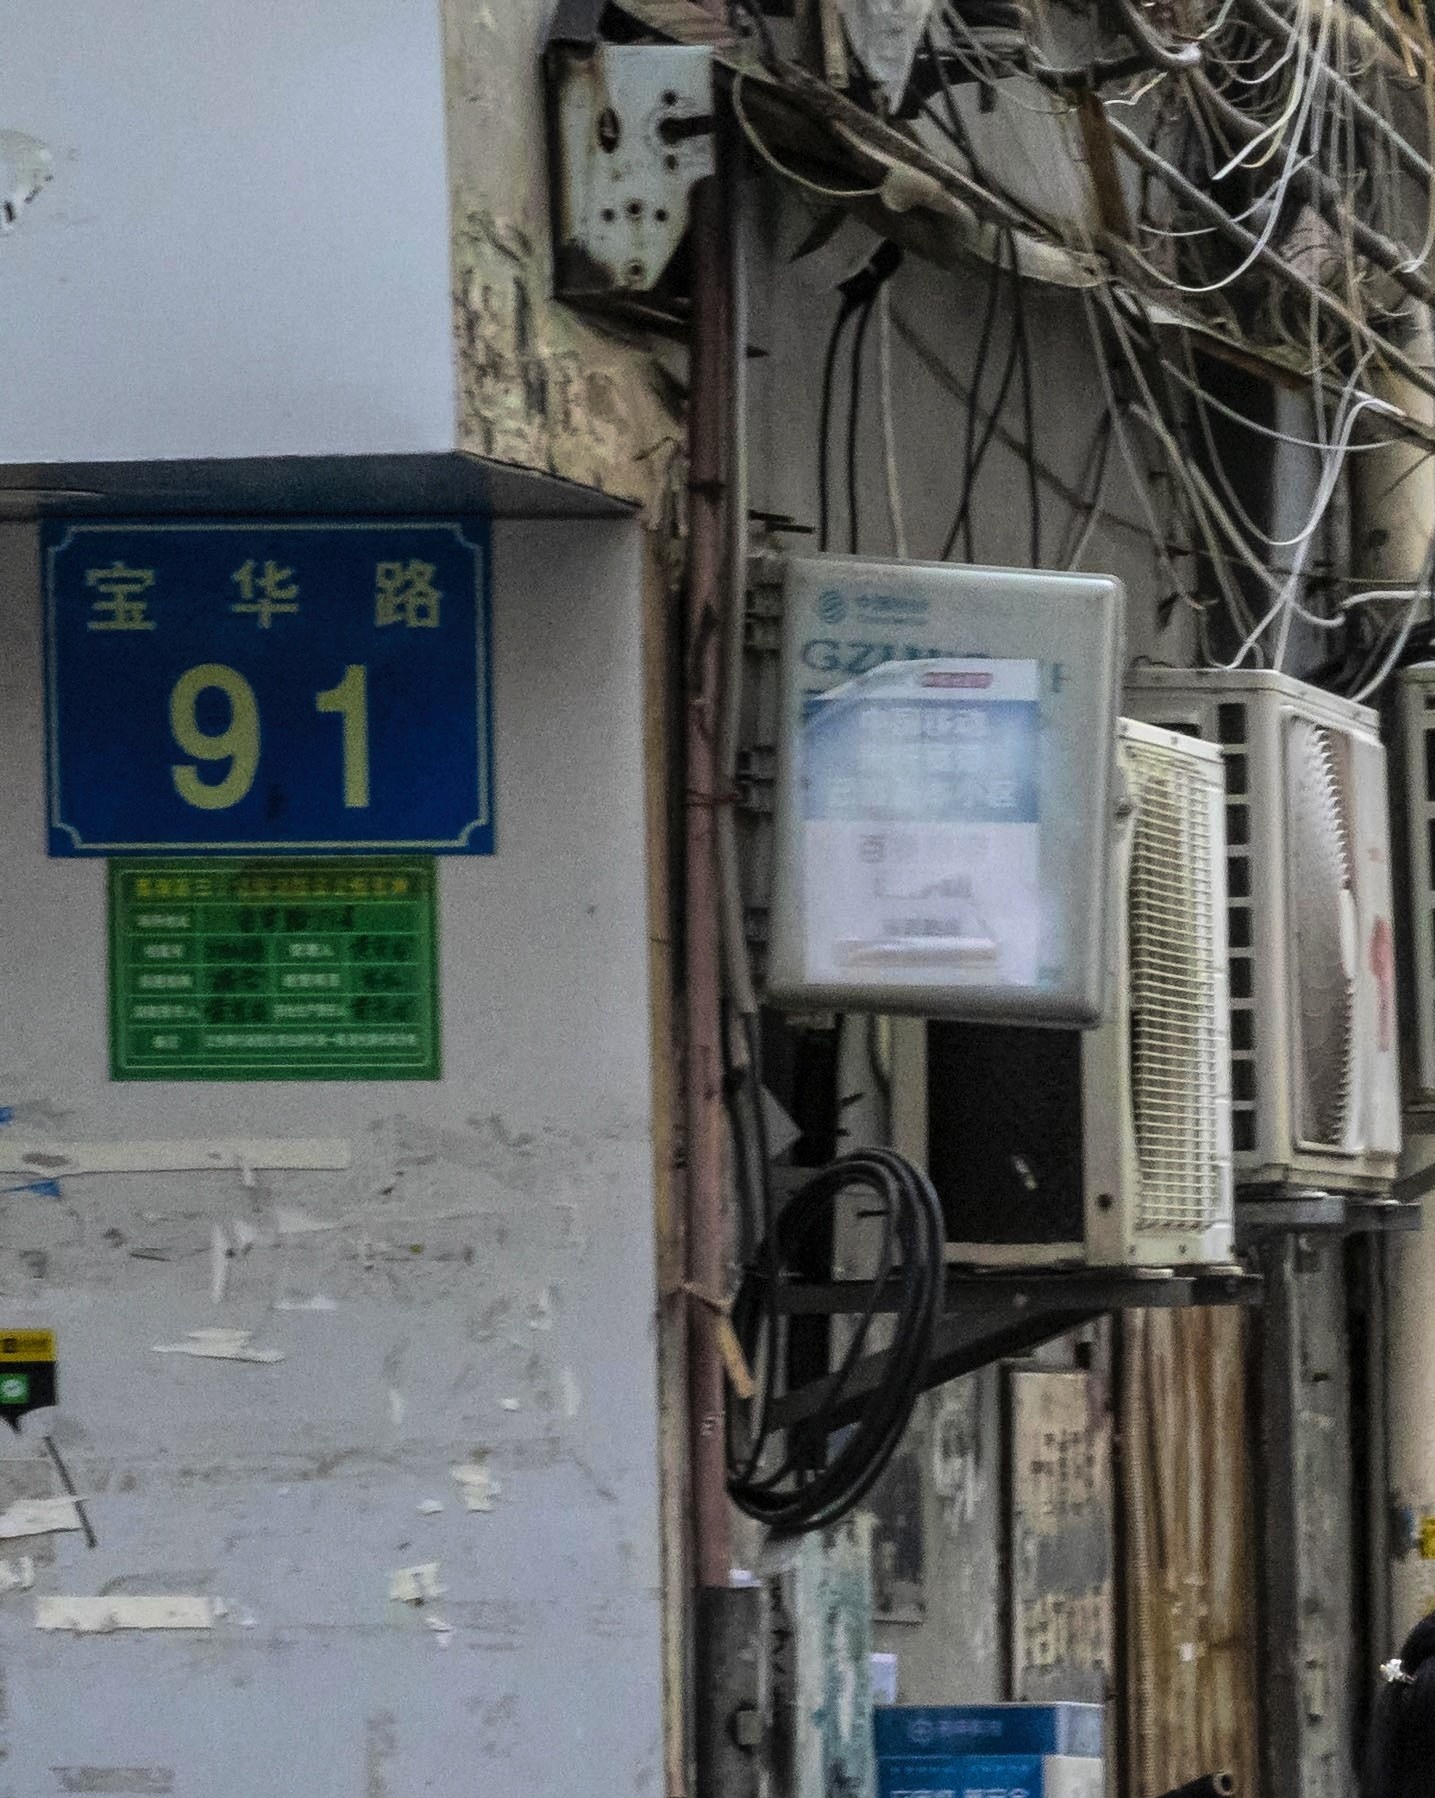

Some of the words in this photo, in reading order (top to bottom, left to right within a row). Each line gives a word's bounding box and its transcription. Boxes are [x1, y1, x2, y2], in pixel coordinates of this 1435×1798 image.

[85, 558, 444, 632] 宝华路
[168, 662, 372, 812] 91
